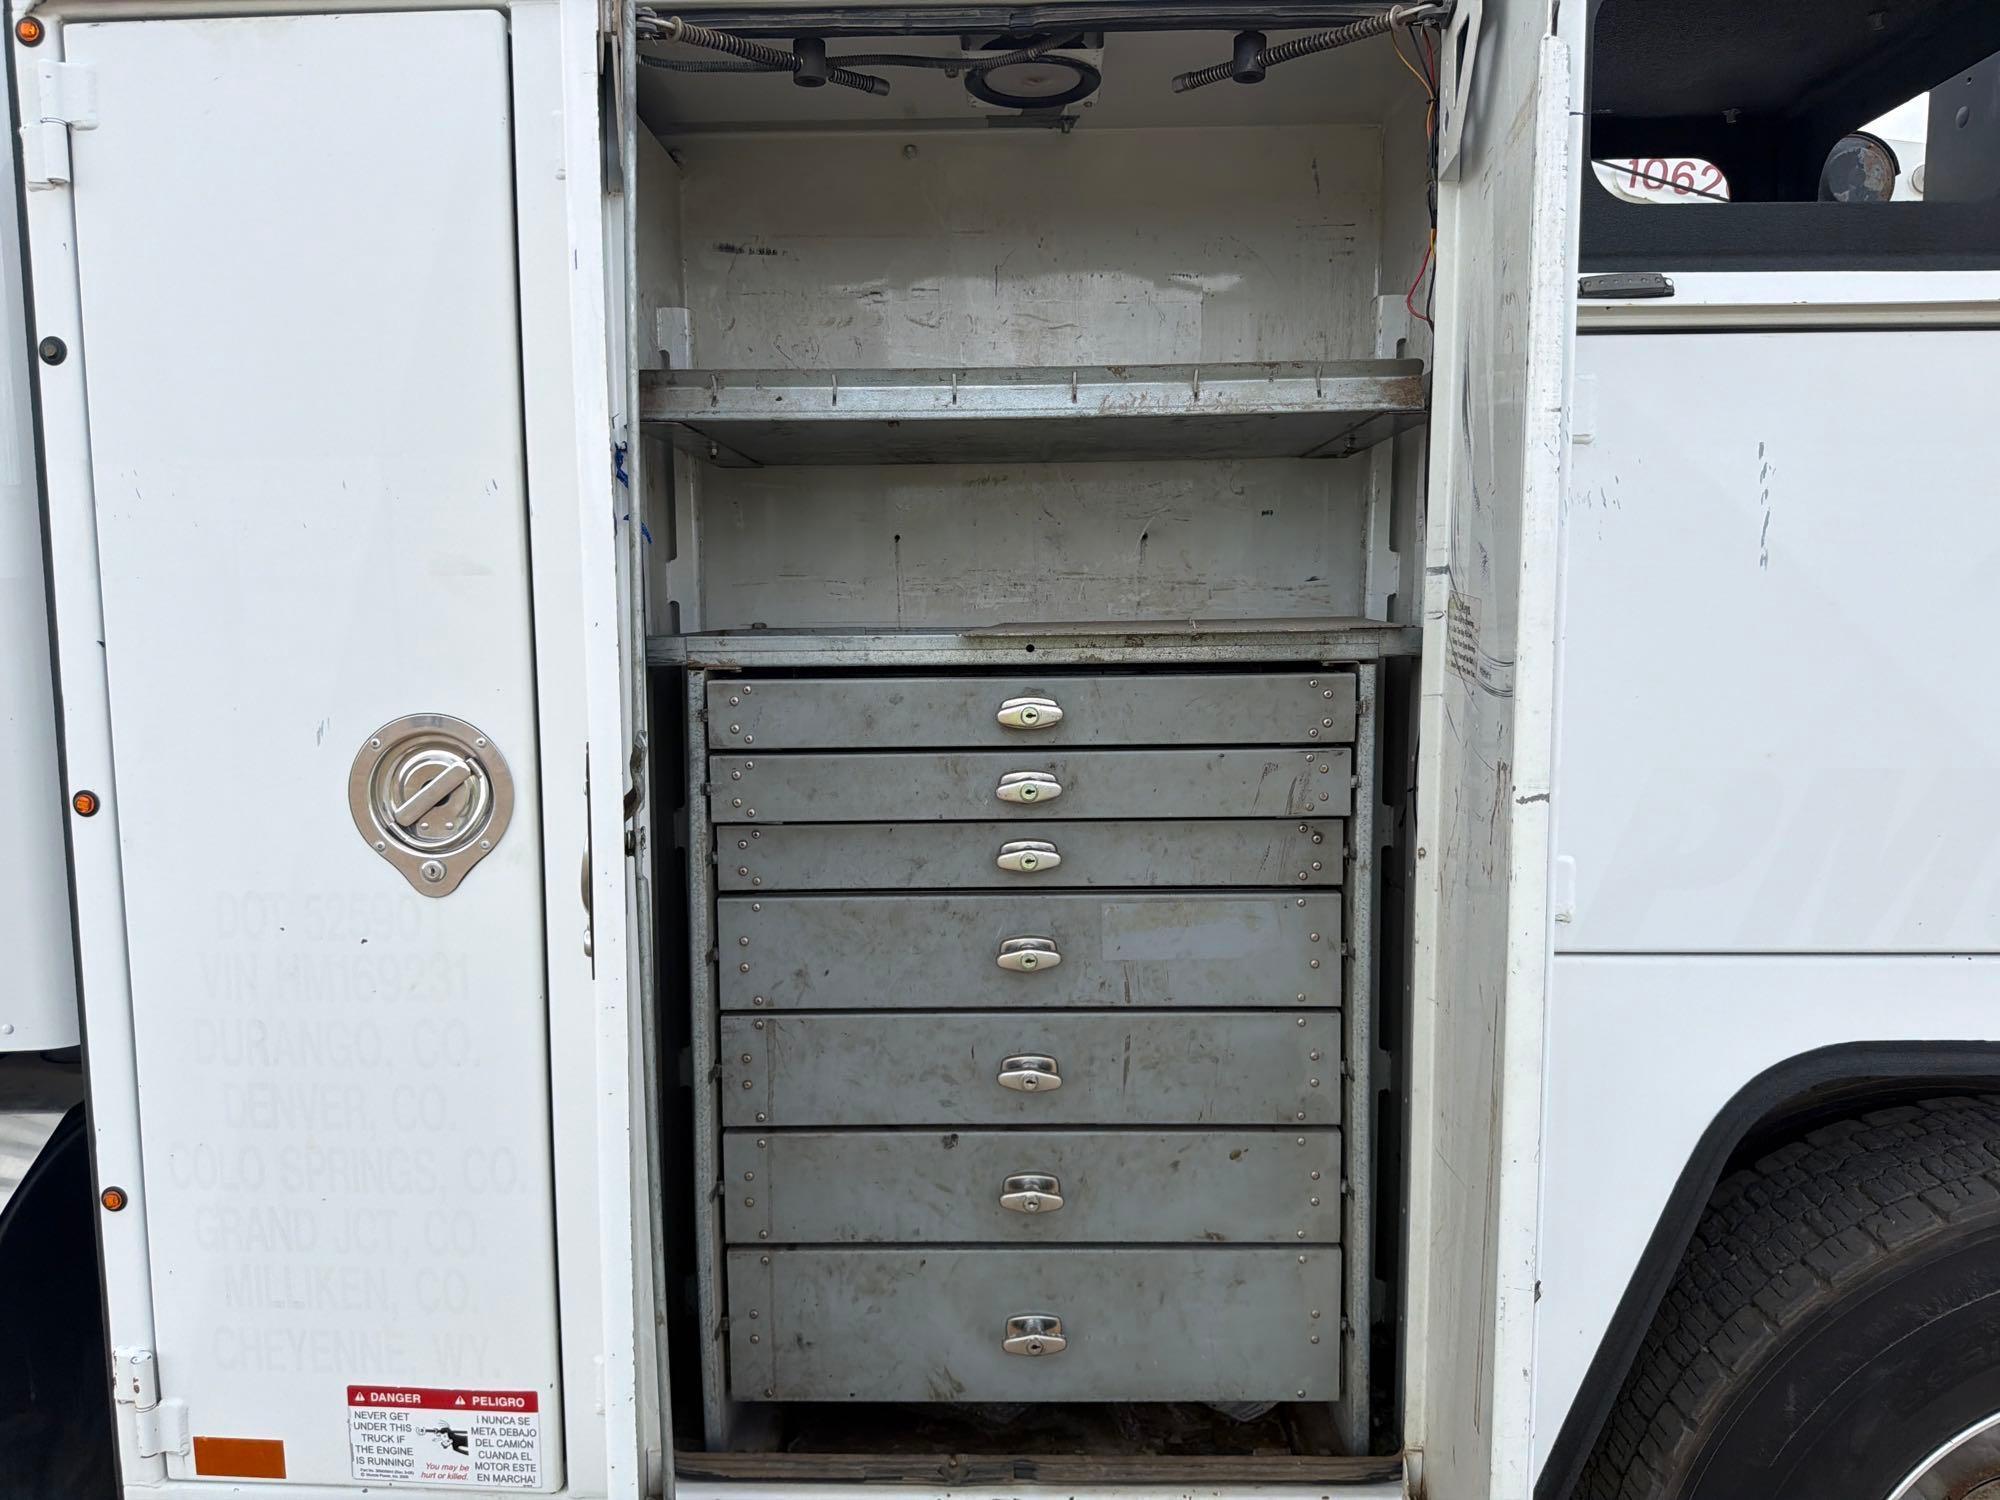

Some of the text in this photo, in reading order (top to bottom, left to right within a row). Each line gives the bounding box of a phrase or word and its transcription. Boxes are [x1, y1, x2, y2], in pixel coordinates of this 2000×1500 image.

[194, 1018, 393, 1072] DURANGO,
[224, 1083, 376, 1140] DENVER,
[170, 1141, 265, 1191] COLO
[280, 1145, 446, 1202] SPRINGS,
[195, 1206, 317, 1253] GRAND
[224, 1266, 399, 1320] MILLIKEN,
[371, 1392, 421, 1404] DANGER
[472, 1396, 525, 1408] PELIGRO
[354, 1411, 409, 1421] NEVER GET
[482, 1416, 515, 1426] NUNCA
[517, 1417, 530, 1425] SE
[353, 1422, 412, 1432] UNDER THIS
[471, 1427, 537, 1437] META DEBAJO
[361, 1434, 405, 1443] TRUCK IF
[476, 1438, 534, 1448] DEL CAMIÓN
[355, 1445, 414, 1455] THE ENGINE
[478, 1451, 532, 1461] CUANDA EL
[356, 1456, 414, 1467] IS RUNNING!
[426, 1462, 440, 1471] You
[441, 1464, 459, 1472] may
[475, 1462, 536, 1473] MOTOR ESTE
[420, 1471, 436, 1479] hurt
[447, 1472, 469, 1480] killed.
[477, 1474, 536, 1484] EN MARCHA!
